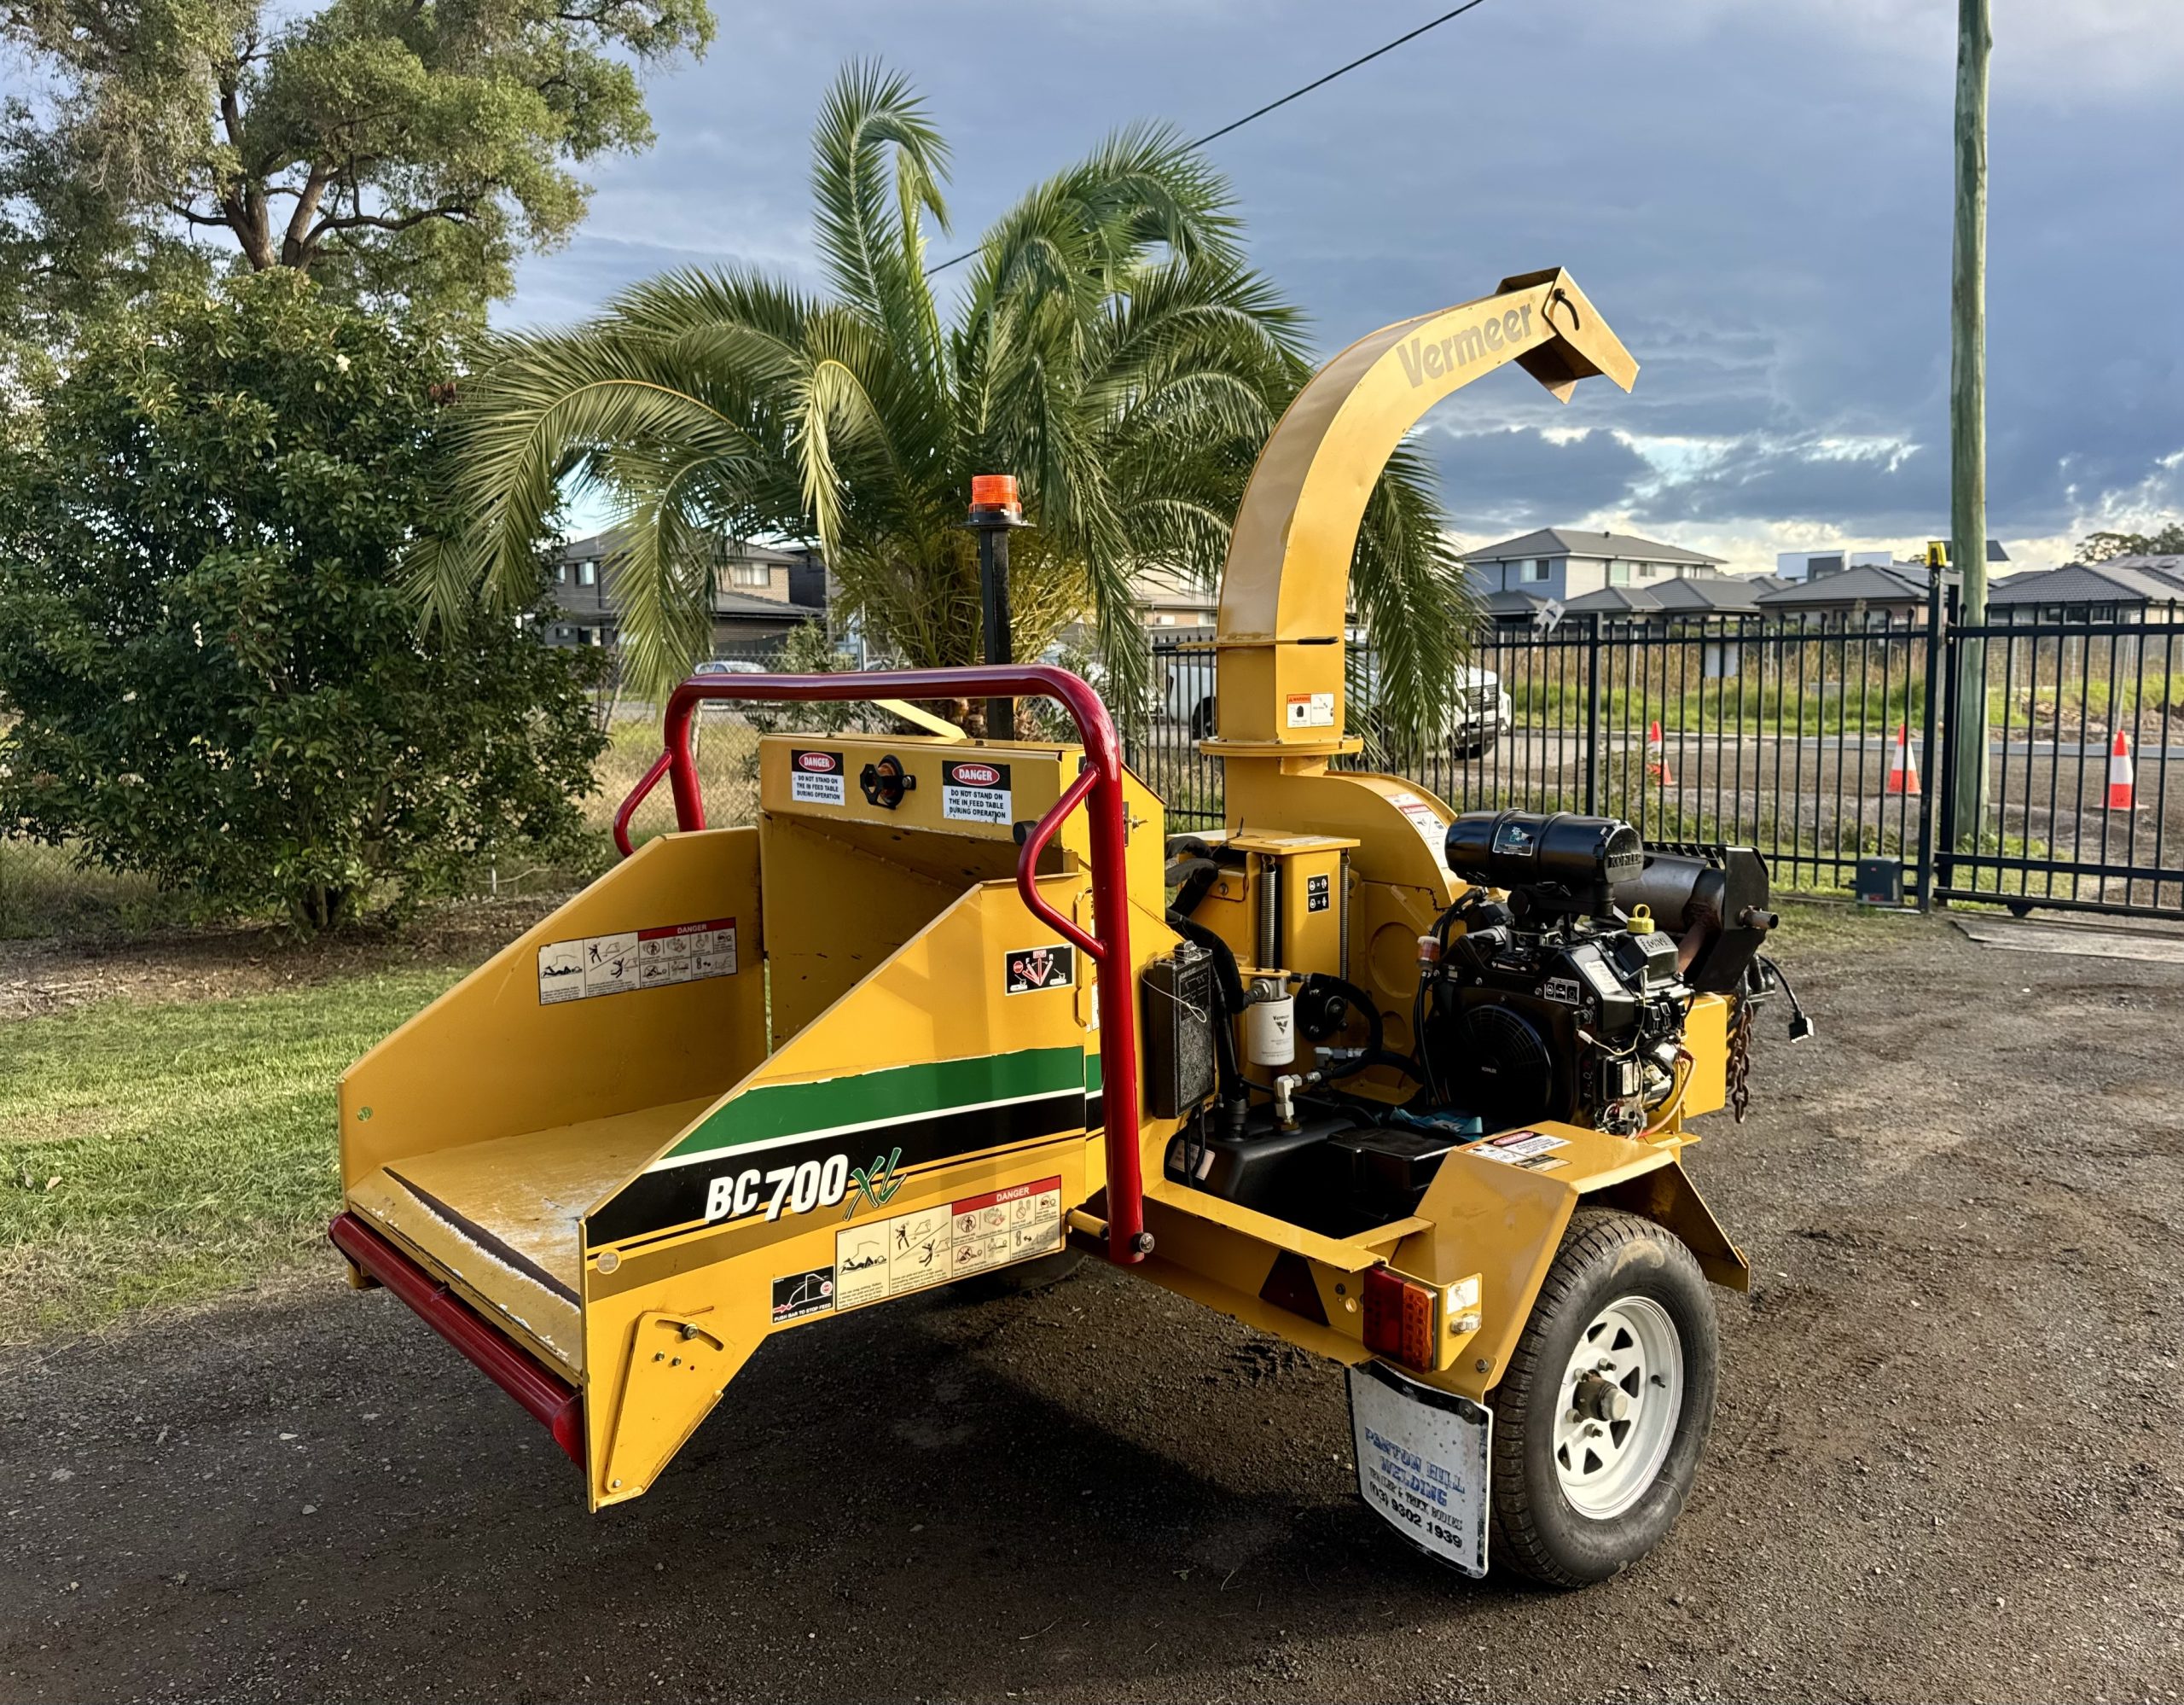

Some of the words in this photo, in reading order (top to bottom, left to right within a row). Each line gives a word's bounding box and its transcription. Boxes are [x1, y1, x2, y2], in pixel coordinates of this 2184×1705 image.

[1397, 304, 1532, 388] Vermeer
[804, 756, 830, 768] DANGER
[958, 767, 993, 782] DANGER
[797, 789, 814, 798] DURING
[815, 791, 840, 800] OPERATION
[973, 791, 992, 800] STAND
[949, 806, 971, 816] DURING
[973, 809, 1006, 818] OPERATION
[985, 801, 1004, 810] TABLE
[1608, 852, 1641, 868] KOHLER
[677, 923, 707, 934] DANGER
[996, 1187, 1030, 1202] DANGER
[1380, 1456, 1447, 1506] WELDING
[1426, 1461, 1466, 1494] HILL
[1369, 1481, 1388, 1507] (03)
[1391, 1499, 1422, 1528] 9302
[1426, 1522, 1461, 1549] 1939
